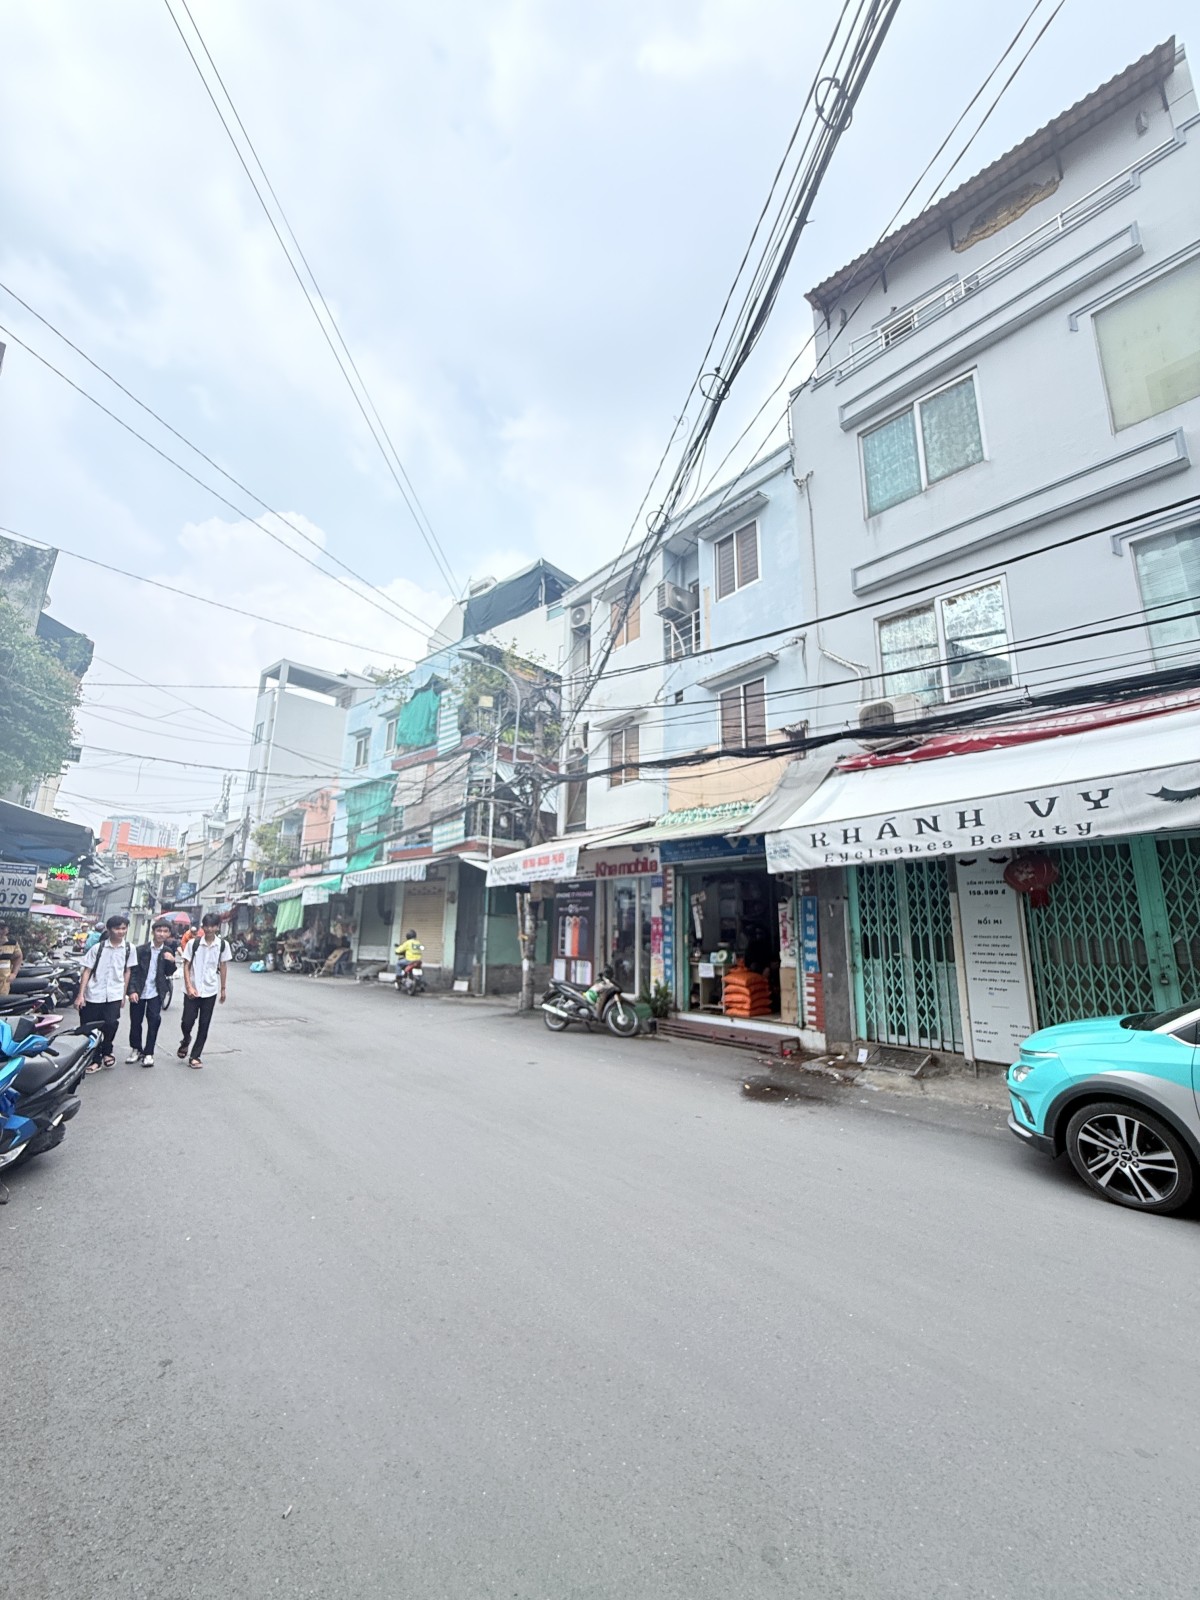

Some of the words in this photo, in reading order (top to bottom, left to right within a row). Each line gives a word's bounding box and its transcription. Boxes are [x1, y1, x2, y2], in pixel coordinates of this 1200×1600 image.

[809, 808, 986, 848] KHÁNH
[1024, 787, 1114, 818] VY
[970, 821, 1093, 848] Beauty
[10, 893, 27, 905] 79
